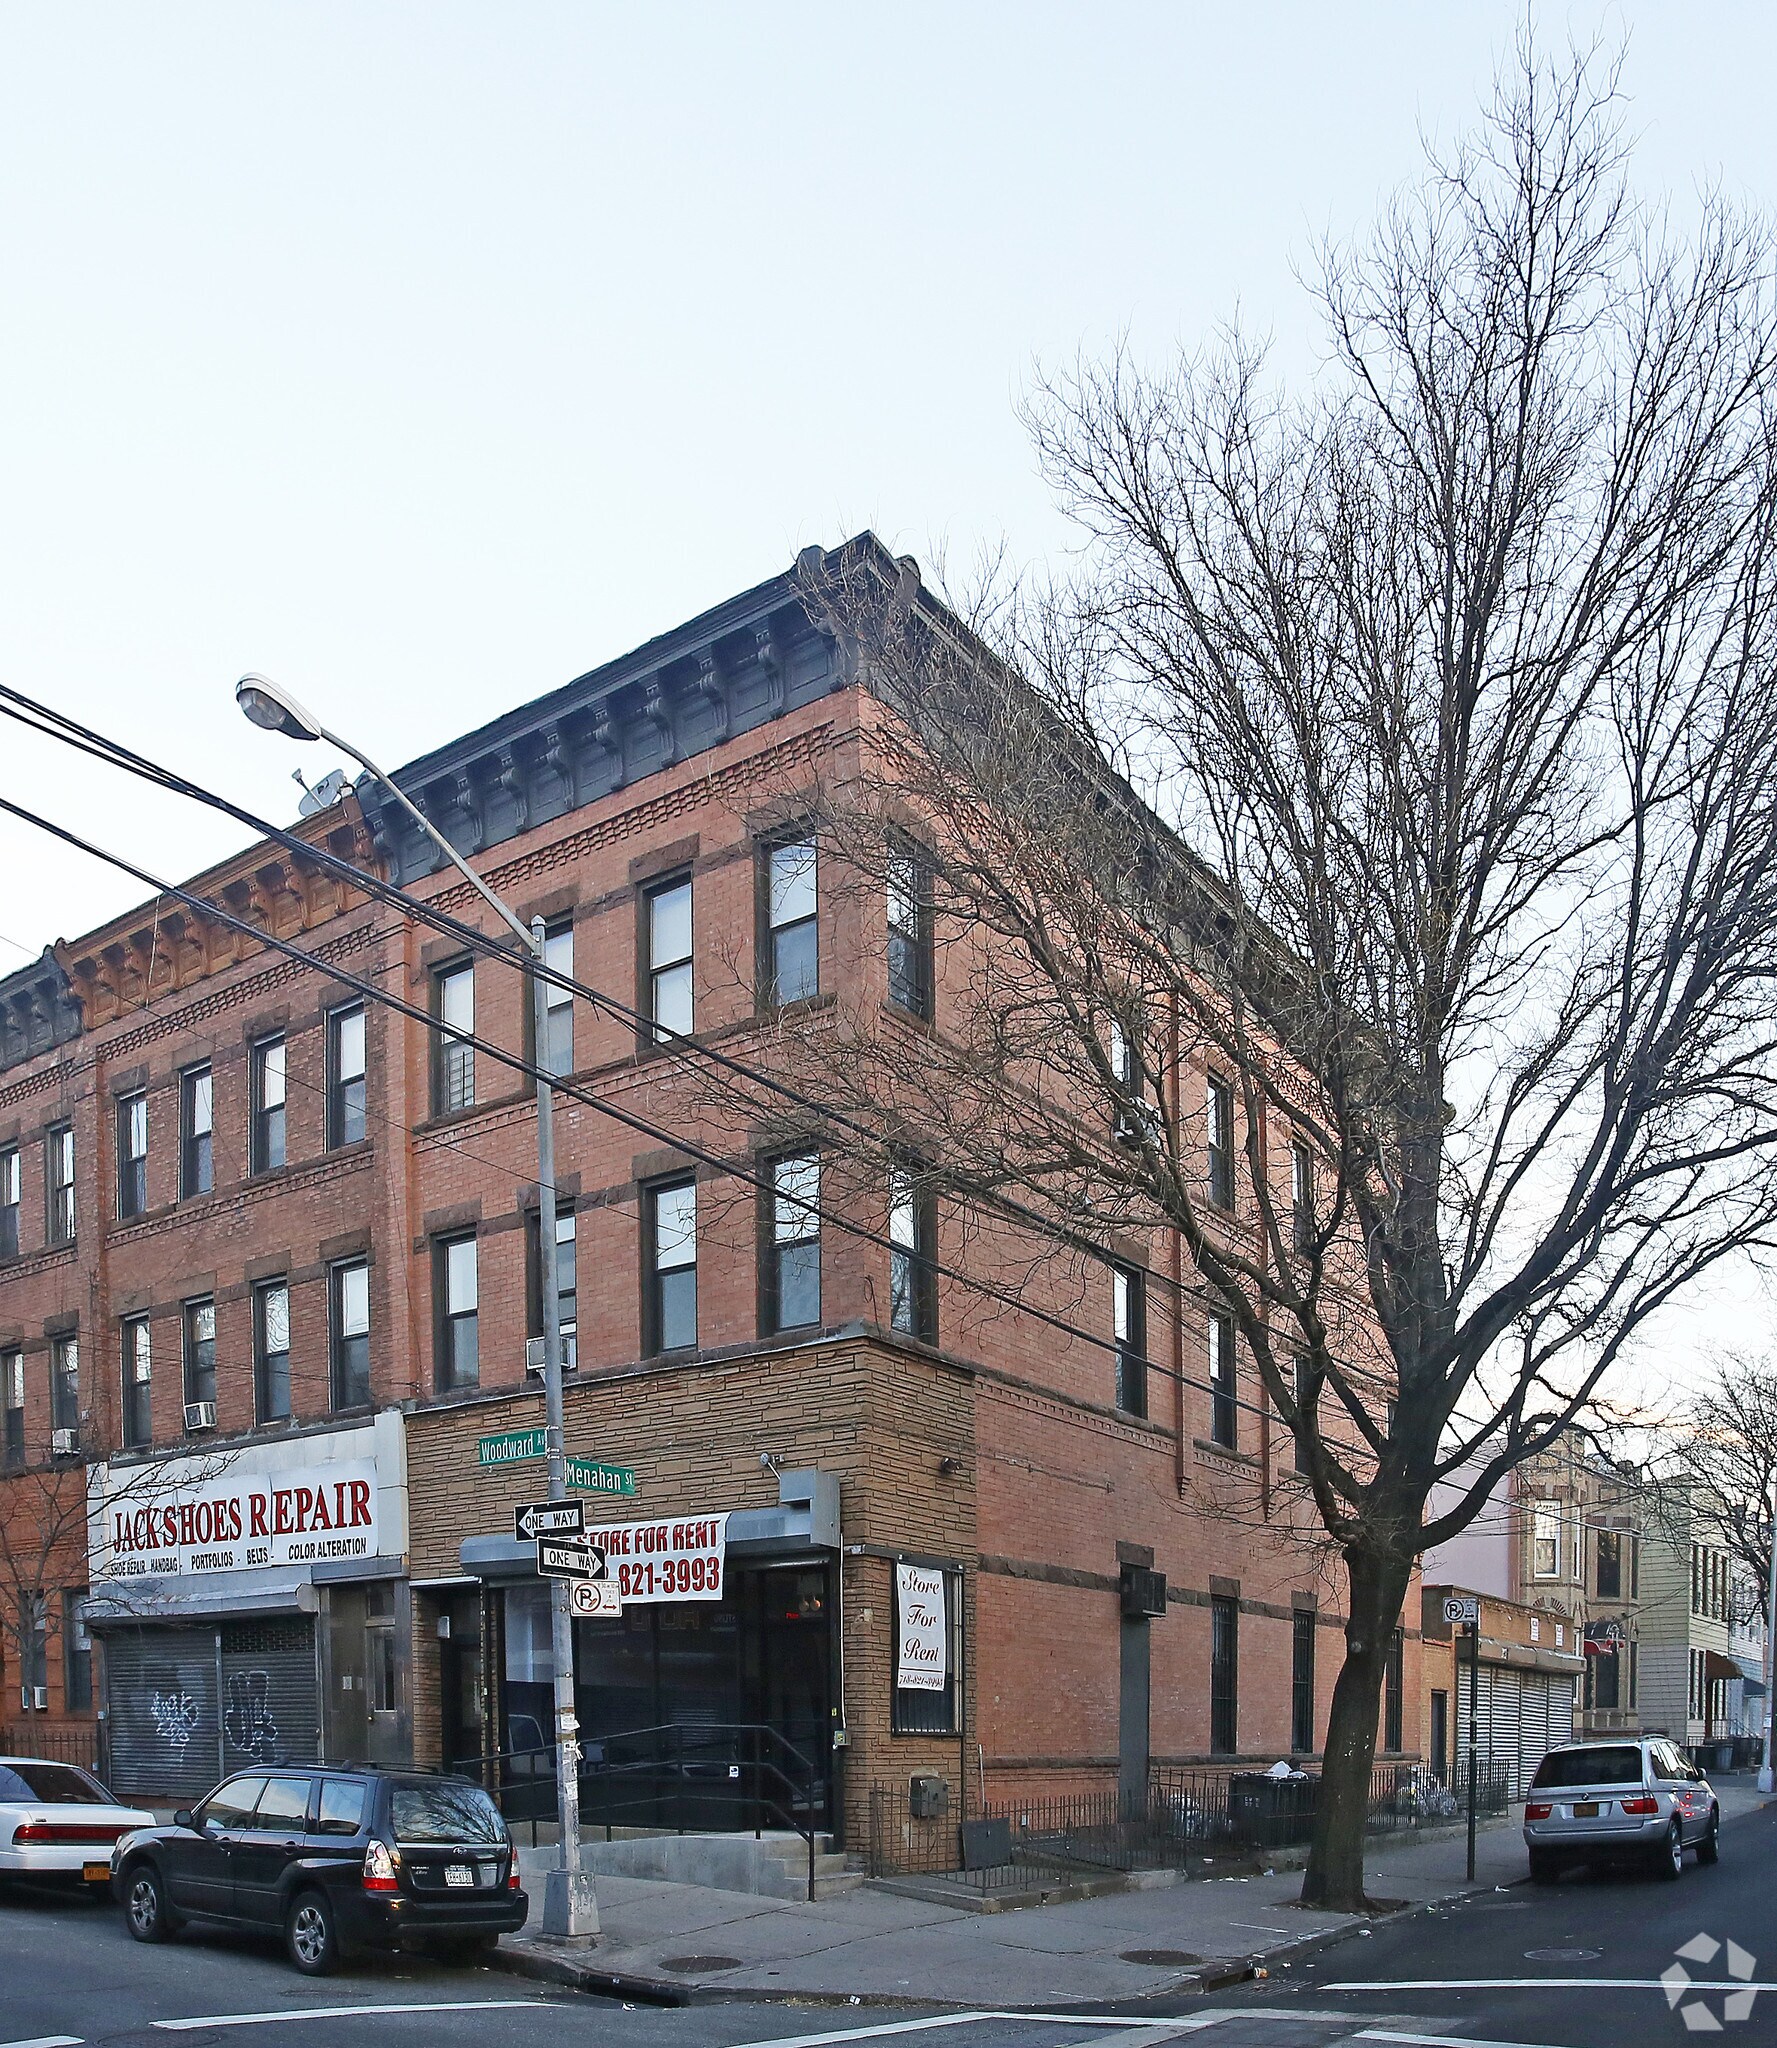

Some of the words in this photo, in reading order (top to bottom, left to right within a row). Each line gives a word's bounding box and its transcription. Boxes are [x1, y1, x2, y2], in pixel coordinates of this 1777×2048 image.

[481, 1433, 534, 1461] Woodward
[566, 1462, 621, 1490] Menahan
[625, 1471, 633, 1486] St
[248, 1480, 373, 1538] REPAIR
[525, 1514, 545, 1530] ONE
[553, 1511, 575, 1526] WAY
[634, 1525, 669, 1553] FOR
[672, 1519, 721, 1550] RENT
[191, 1551, 234, 1570] PORTFOLIOS
[246, 1547, 268, 1565] BELTS
[288, 1542, 316, 1560] COLOR
[317, 1537, 367, 1558] ALTERATION
[549, 1550, 570, 1566] ONE
[577, 1554, 597, 1571] WAY
[618, 1556, 720, 1597] 821-3993
[902, 1569, 940, 1595] Store
[907, 1603, 937, 1627] For
[903, 1637, 939, 1662] Rent
